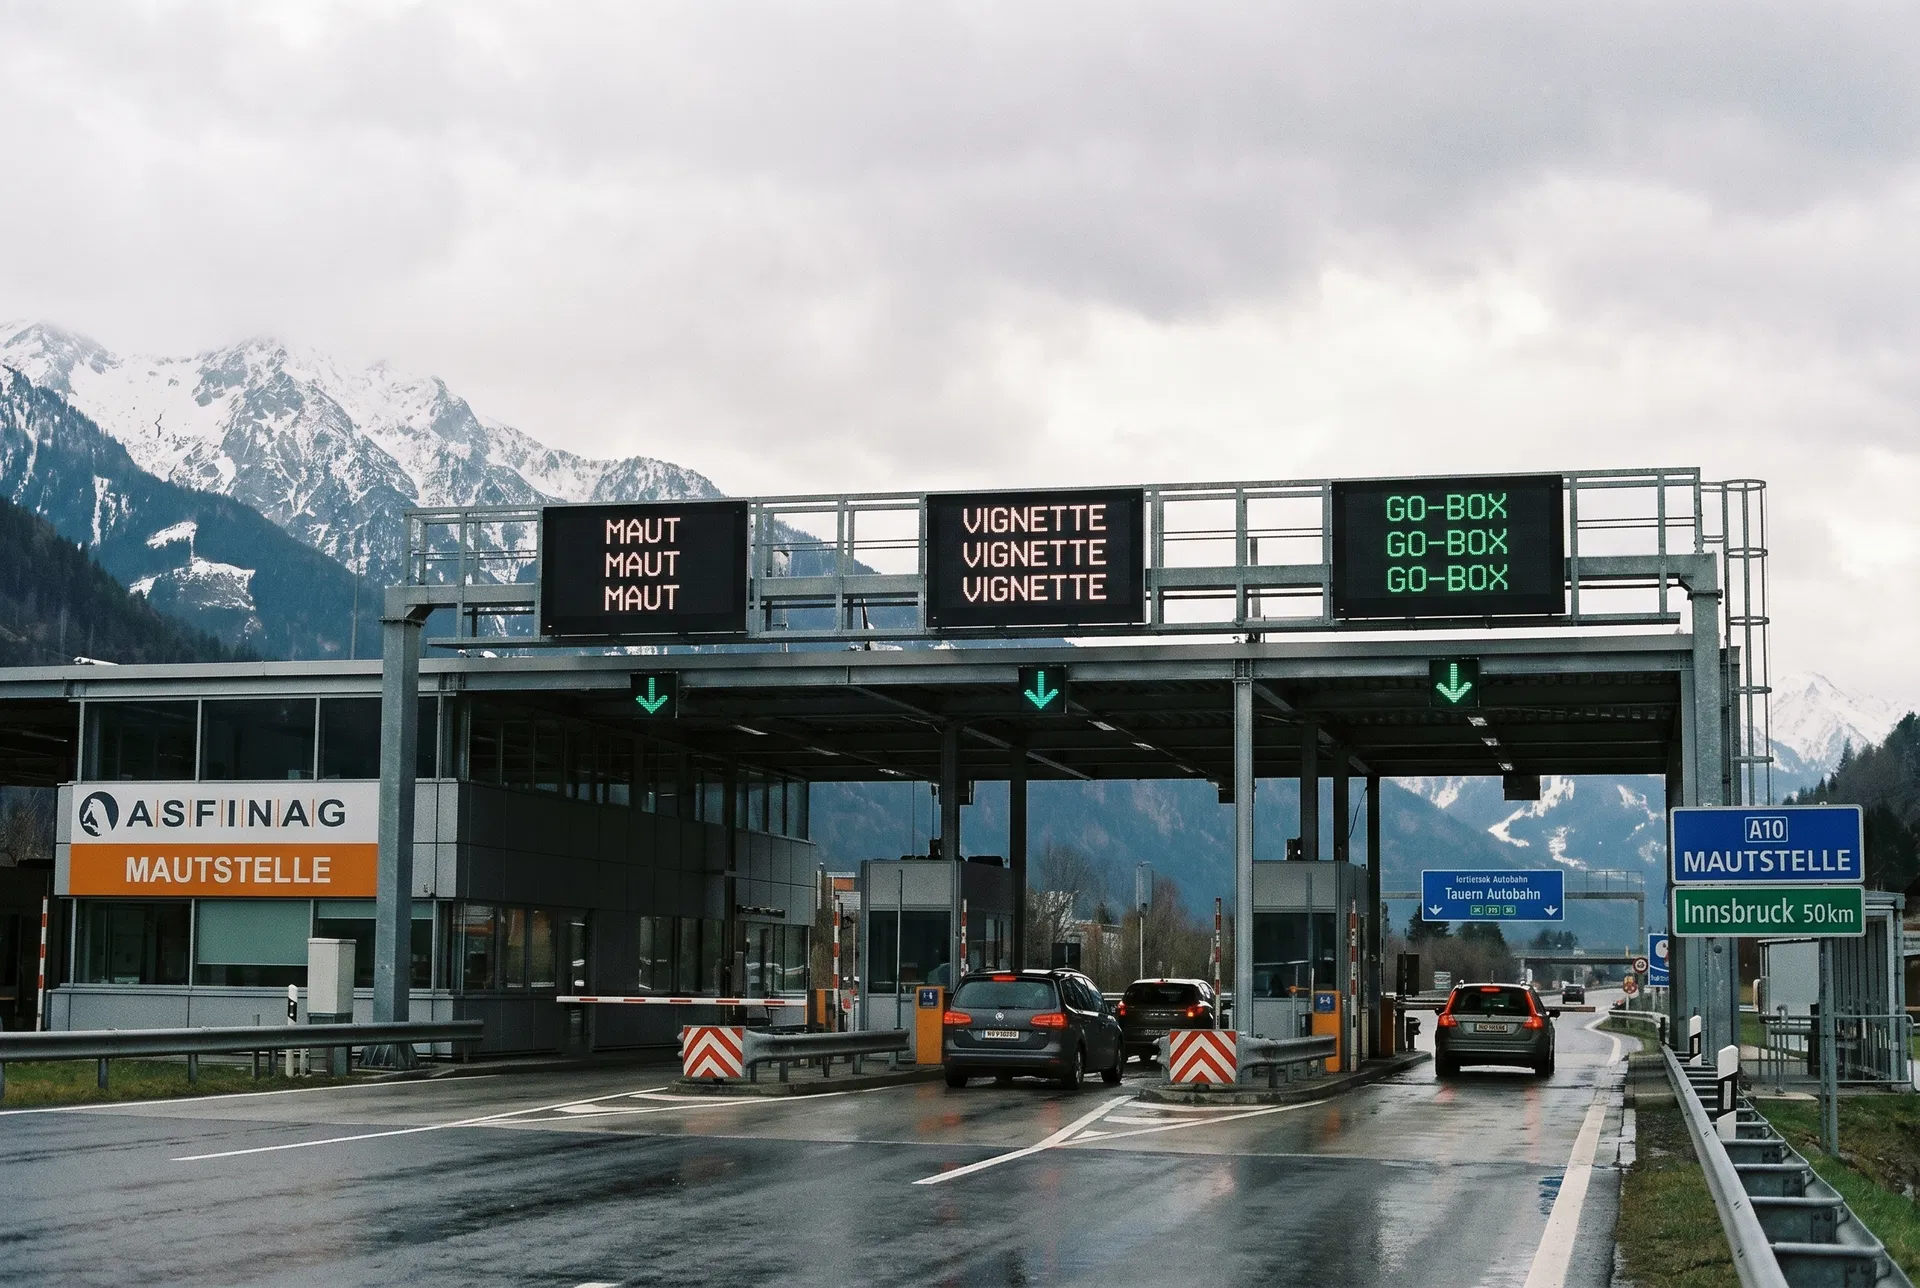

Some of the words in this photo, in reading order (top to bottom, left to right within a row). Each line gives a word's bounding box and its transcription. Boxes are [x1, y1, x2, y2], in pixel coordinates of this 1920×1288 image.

[963, 503, 1108, 534] VIGNETTE
[1385, 491, 1508, 522] GO-BOX
[604, 516, 682, 545] MAUT
[1385, 527, 1509, 558] GO-BOX
[604, 550, 681, 579] MAUT
[963, 538, 1108, 569] VIGNETTE
[963, 573, 1108, 603] VIGNETTE
[1386, 562, 1509, 593] GO-BOX
[604, 583, 681, 611] MAUT
[1749, 819, 1784, 840] A10
[125, 856, 332, 884] MAUTSTELLE
[1684, 849, 1852, 873] MAUTSTELLE
[1445, 887, 1483, 900] Tauern
[1487, 887, 1541, 900] Autobahn
[1493, 875, 1529, 884] Autobahn
[1684, 897, 1795, 924] Innsbruck
